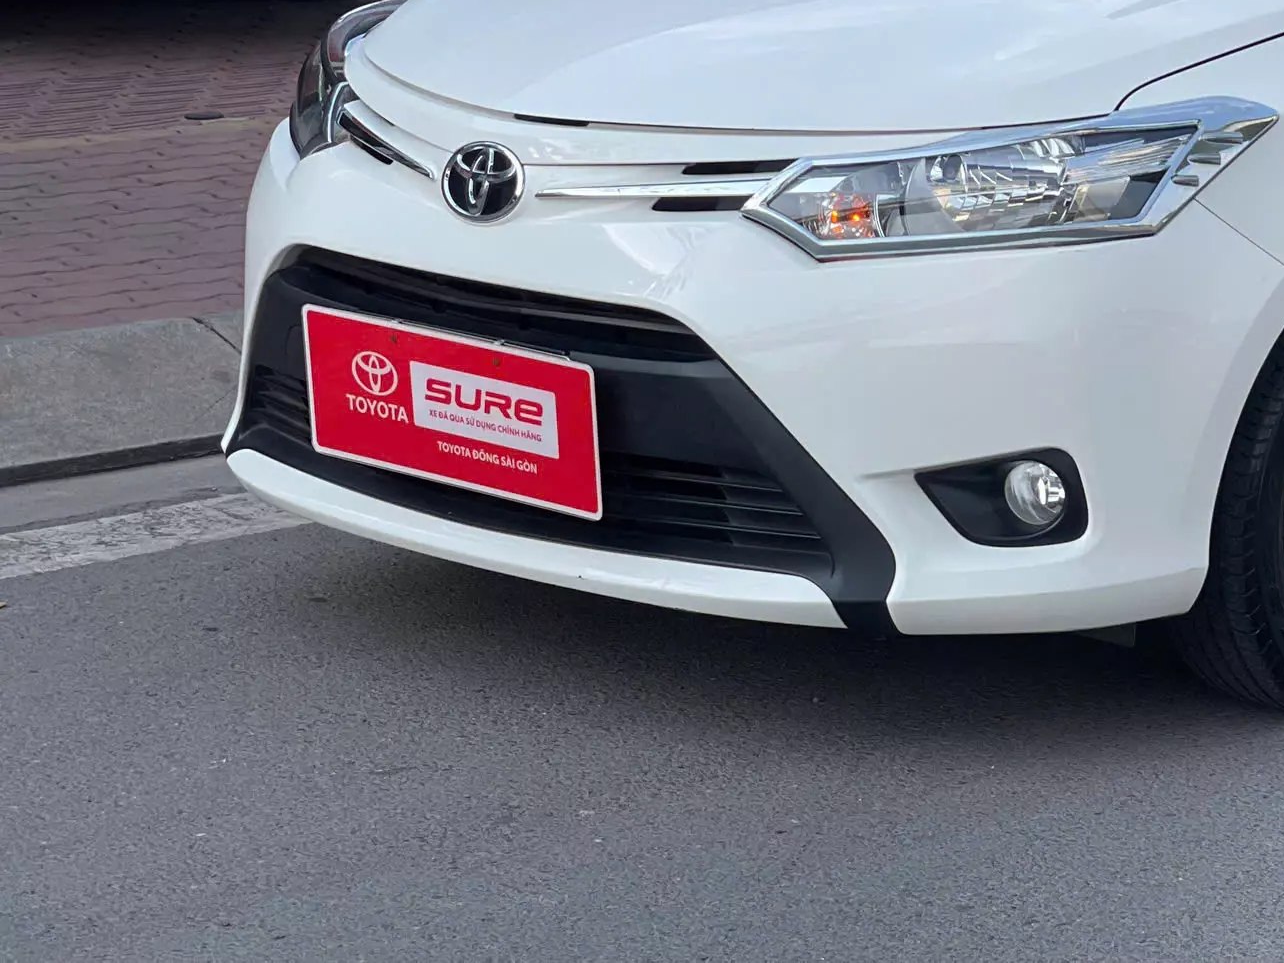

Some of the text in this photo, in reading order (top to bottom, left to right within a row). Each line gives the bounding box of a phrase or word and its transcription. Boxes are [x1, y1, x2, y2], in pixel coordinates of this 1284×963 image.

[346, 393, 409, 424] TOYOTA
[429, 409, 438, 418] XE
[449, 413, 465, 424] QUA
[437, 441, 538, 474] TOYOTA ĐÔNG SÀI GÒN
